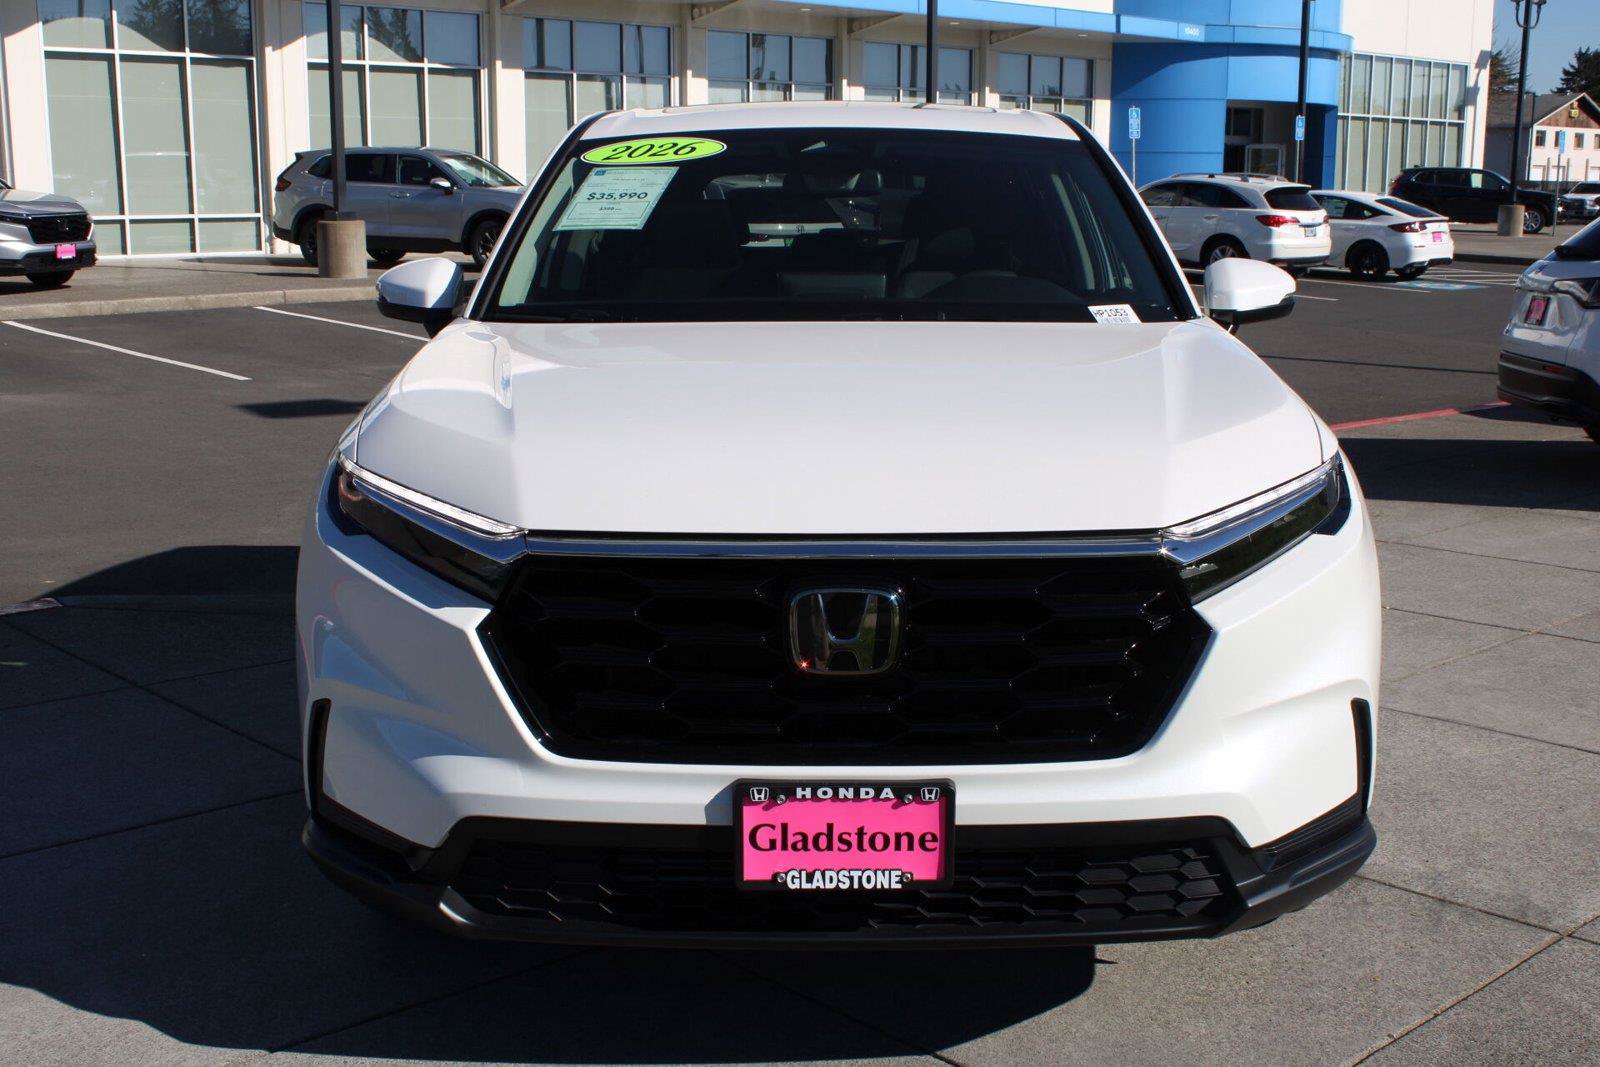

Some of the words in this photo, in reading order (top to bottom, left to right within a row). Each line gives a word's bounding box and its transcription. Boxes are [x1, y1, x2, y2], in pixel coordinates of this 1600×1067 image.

[601, 141, 706, 161] 2026
[796, 787, 895, 799] HONDA
[748, 822, 939, 852] Gladstone
[786, 869, 903, 890] GLADSTONE
